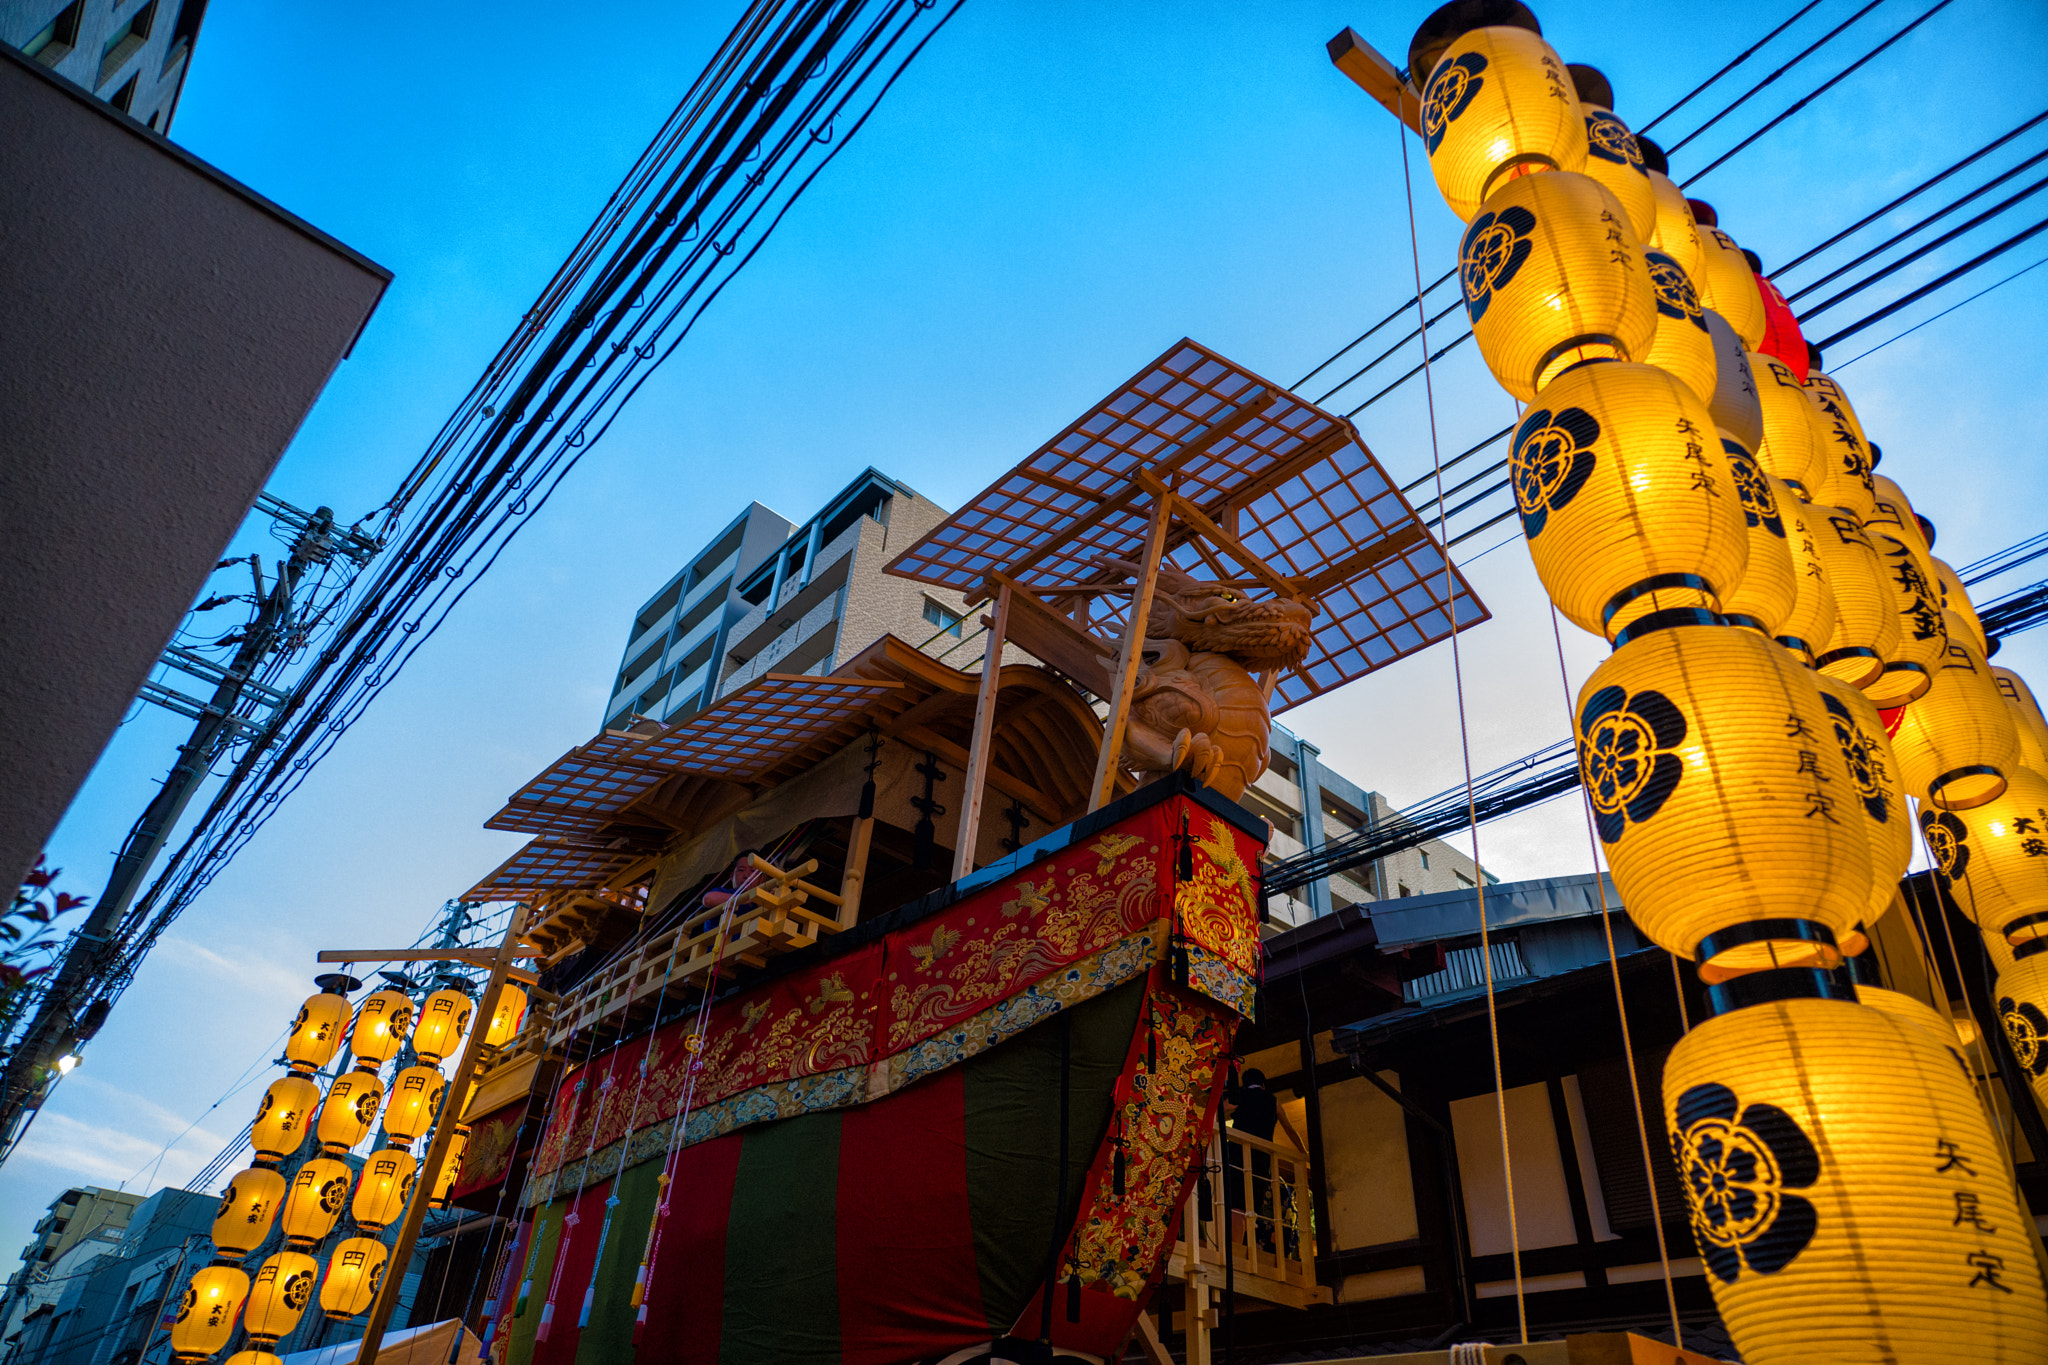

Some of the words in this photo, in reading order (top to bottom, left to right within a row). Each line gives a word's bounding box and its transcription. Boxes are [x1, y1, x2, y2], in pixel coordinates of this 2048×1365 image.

[1600, 209, 1634, 272] 矢尾定
[1675, 417, 1721, 498] 矢尾定
[1785, 714, 1840, 825] 矢尾定
[366, 998, 386, 1015] 四
[432, 998, 454, 1016] 四
[316, 1021, 331, 1042] 大安
[332, 1081, 352, 1099] 四
[403, 1075, 426, 1094] 四
[281, 1110, 296, 1132] 大安
[295, 1170, 316, 1189] 四
[374, 1159, 397, 1179] 四
[246, 1202, 262, 1225] 大安
[1934, 1137, 2014, 1295] 矢尾定
[342, 1249, 366, 1270] 四
[258, 1264, 278, 1285] 四
[207, 1303, 224, 1328] 大安
